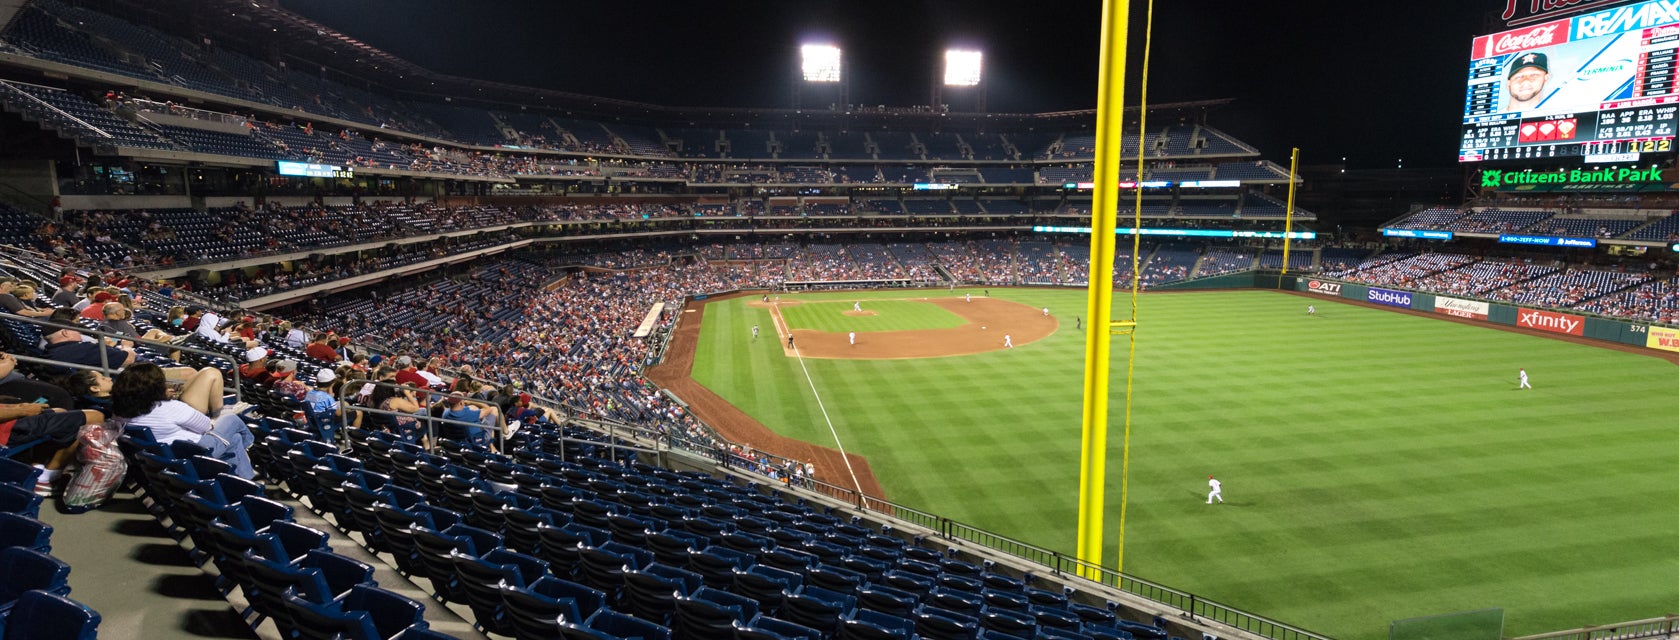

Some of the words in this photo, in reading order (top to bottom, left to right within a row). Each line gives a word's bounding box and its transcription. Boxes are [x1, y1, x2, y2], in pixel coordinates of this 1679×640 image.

[1576, 0, 1679, 40] RE/MAX
[1495, 24, 1558, 53] Coca-Cola
[1583, 65, 1623, 76] TERMINIX
[1630, 142, 1638, 152] 1
[1644, 141, 1654, 151] 2
[1658, 141, 1669, 151] 2
[1504, 171, 1566, 184] Citizens
[1570, 169, 1615, 182] Bank
[1618, 167, 1662, 182] Park
[1319, 282, 1341, 292] ATI
[1368, 290, 1410, 305] StubHub
[1448, 310, 1472, 318] LAGER
[1521, 311, 1579, 332] xfinity
[1630, 325, 1646, 333] 374
